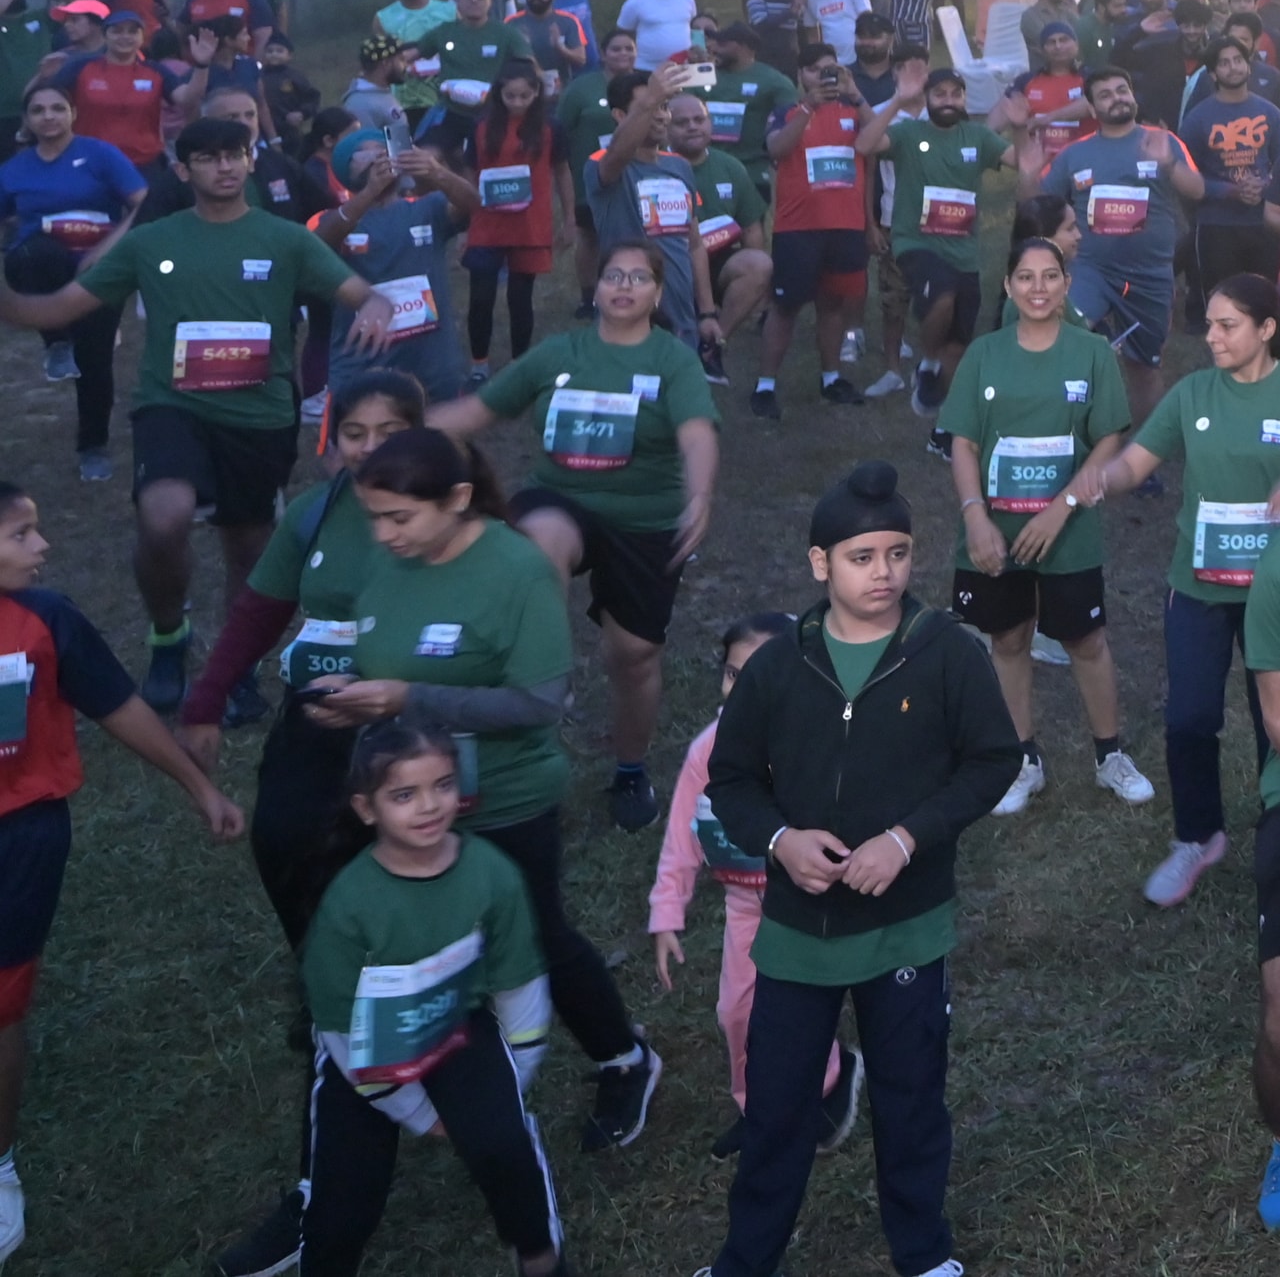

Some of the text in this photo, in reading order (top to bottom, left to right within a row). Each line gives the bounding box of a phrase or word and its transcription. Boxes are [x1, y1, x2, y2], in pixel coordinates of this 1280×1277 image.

[938, 204, 967, 217] 5220
[1103, 203, 1136, 214] 5260
[202, 347, 252, 361] 5432
[1011, 465, 1058, 480] 3026
[1217, 533, 1269, 551] 3086
